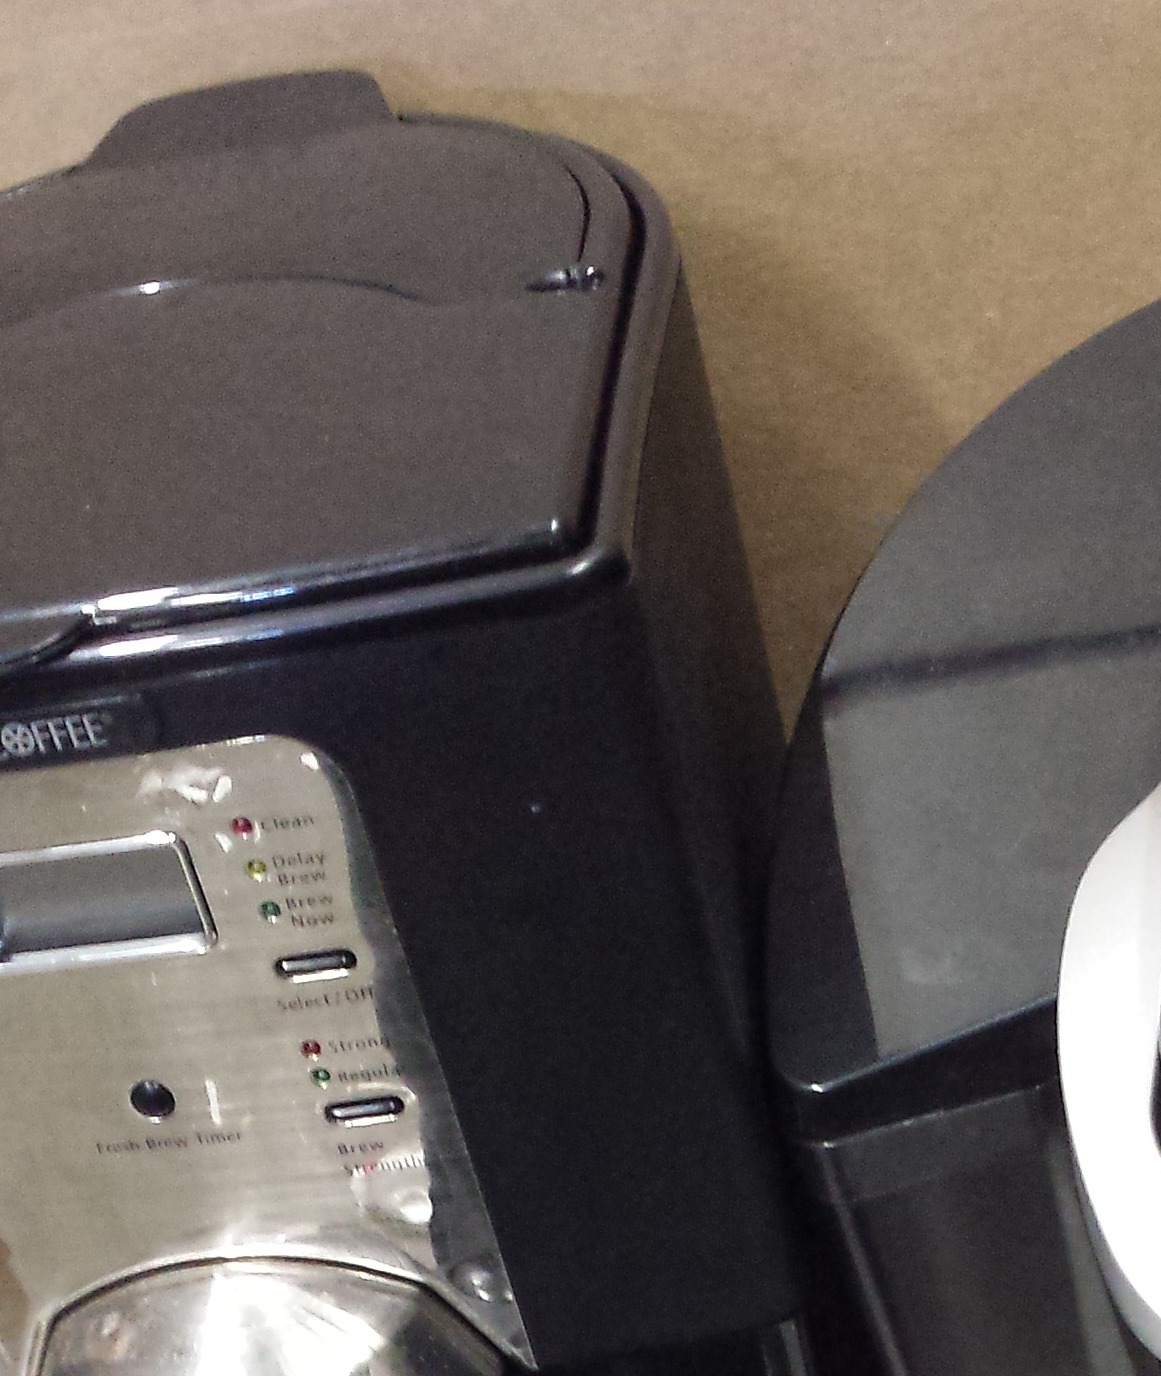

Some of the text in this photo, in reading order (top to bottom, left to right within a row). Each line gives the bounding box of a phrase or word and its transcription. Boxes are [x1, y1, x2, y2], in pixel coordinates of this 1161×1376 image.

[0, 713, 109, 759] OFFEE
[272, 853, 326, 868] Delay
[277, 871, 327, 887] Brew
[286, 897, 334, 910] Brew
[291, 914, 335, 928] Now
[337, 1141, 384, 1155] Brew
